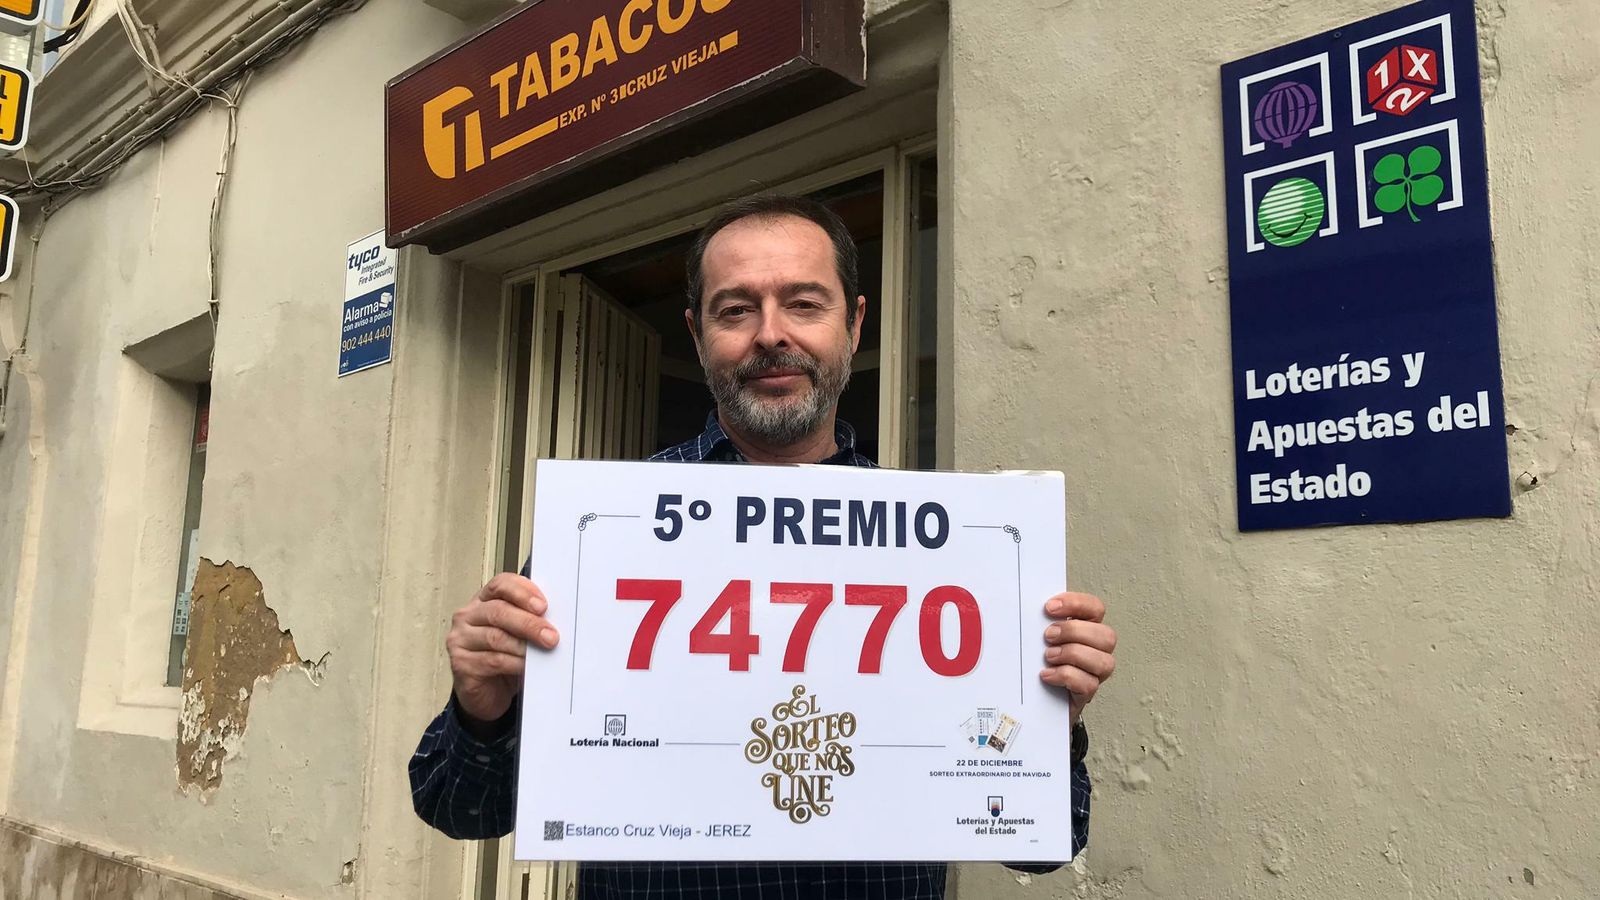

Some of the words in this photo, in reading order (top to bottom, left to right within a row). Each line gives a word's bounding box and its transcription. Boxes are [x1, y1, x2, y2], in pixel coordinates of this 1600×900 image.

[490, 0, 733, 119] TABACO
[559, 104, 587, 129] EXP.
[610, 88, 619, 105] 3
[626, 64, 668, 96] CRUZ
[671, 41, 719, 75] VIEJA
[348, 245, 381, 271] tyco
[361, 256, 387, 274] Integrated
[343, 323, 354, 333] con
[354, 317, 369, 329] aviso
[344, 301, 379, 324] Alarma
[342, 336, 357, 353] 902
[357, 330, 373, 347] 444
[374, 324, 391, 341] 440
[1246, 353, 1391, 400] Loterías
[1402, 351, 1425, 388] y
[1247, 407, 1415, 458] Apuestas
[1427, 390, 1491, 433] del
[1250, 463, 1372, 504] Estado
[653, 494, 712, 542] 5º
[735, 496, 950, 550] PREMIO
[615, 578, 983, 677] 74770
[570, 737, 610, 748] Lotería
[612, 738, 660, 748] Nacional
[744, 711, 857, 764] SORTEO
[772, 752, 811, 775] QUE
[814, 741, 856, 777] NOS
[956, 759, 966, 767] 22
[968, 759, 979, 767] DE
[980, 759, 1024, 768] DICIEMBRE
[761, 772, 834, 824] UNE
[566, 823, 620, 838] Estanco
[623, 824, 655, 837] Cruz
[659, 824, 692, 840] Vieja
[704, 824, 752, 838] JEREZ
[956, 817, 990, 826] Loterías
[991, 818, 997, 827] y
[998, 817, 1035, 827] Apuestas
[975, 826, 988, 836] del
[989, 826, 1017, 835] Estado
